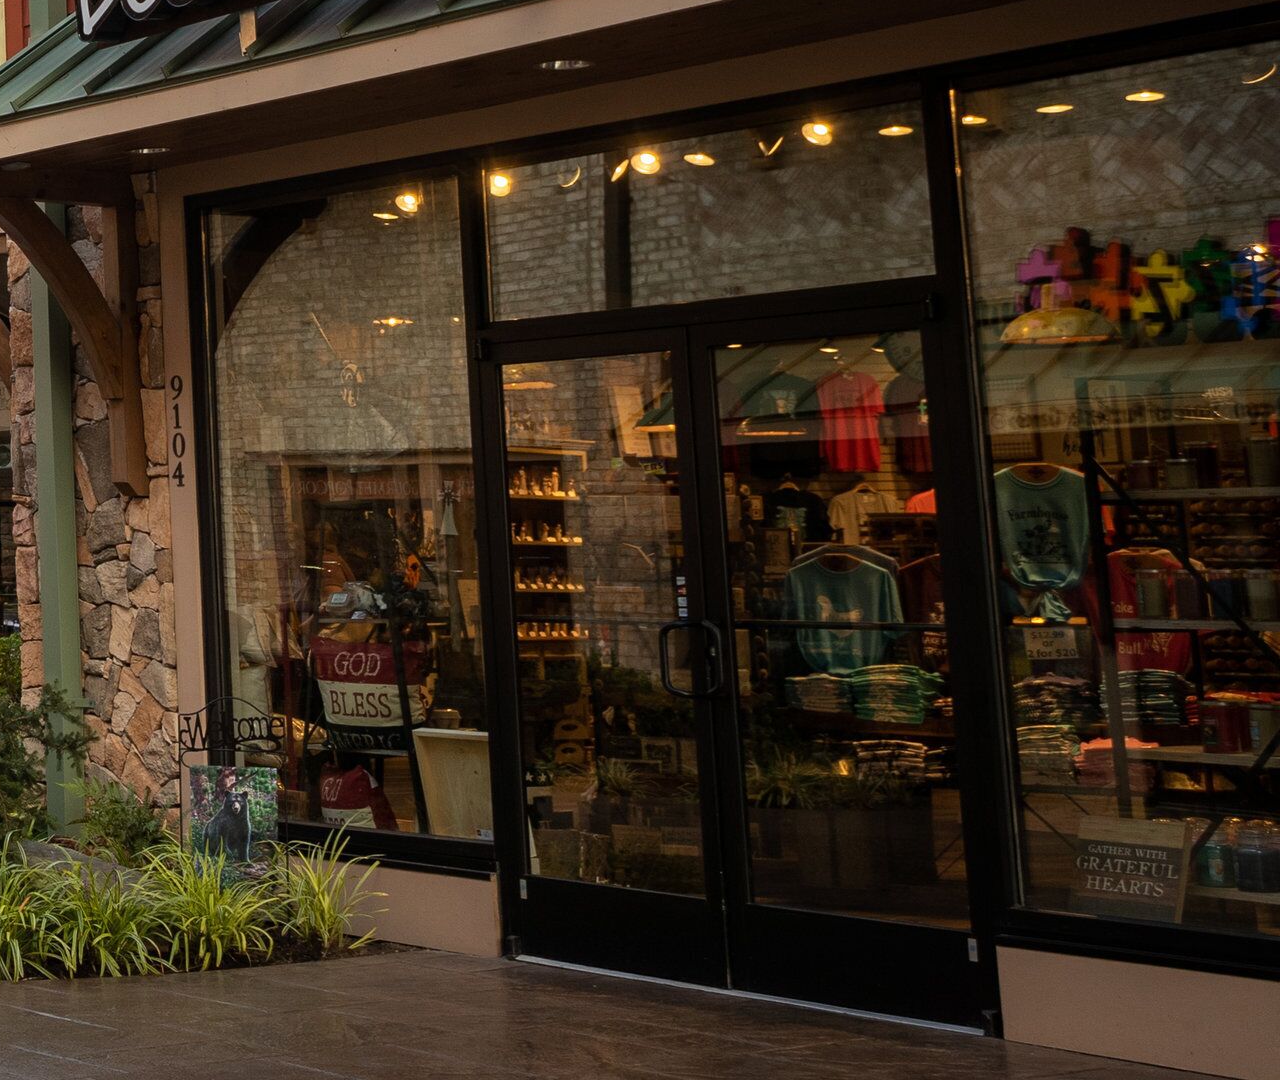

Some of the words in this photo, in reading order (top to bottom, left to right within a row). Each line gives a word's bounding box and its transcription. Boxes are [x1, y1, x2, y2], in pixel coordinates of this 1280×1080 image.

[170, 375, 186, 487] 9104
[334, 650, 381, 677] GOD
[329, 689, 392, 719] BLESS
[1087, 843, 1132, 857] GATHER
[1135, 847, 1168, 862] WITH
[1075, 854, 1180, 880] GRATEFUL
[1085, 874, 1165, 899] HEARTS
